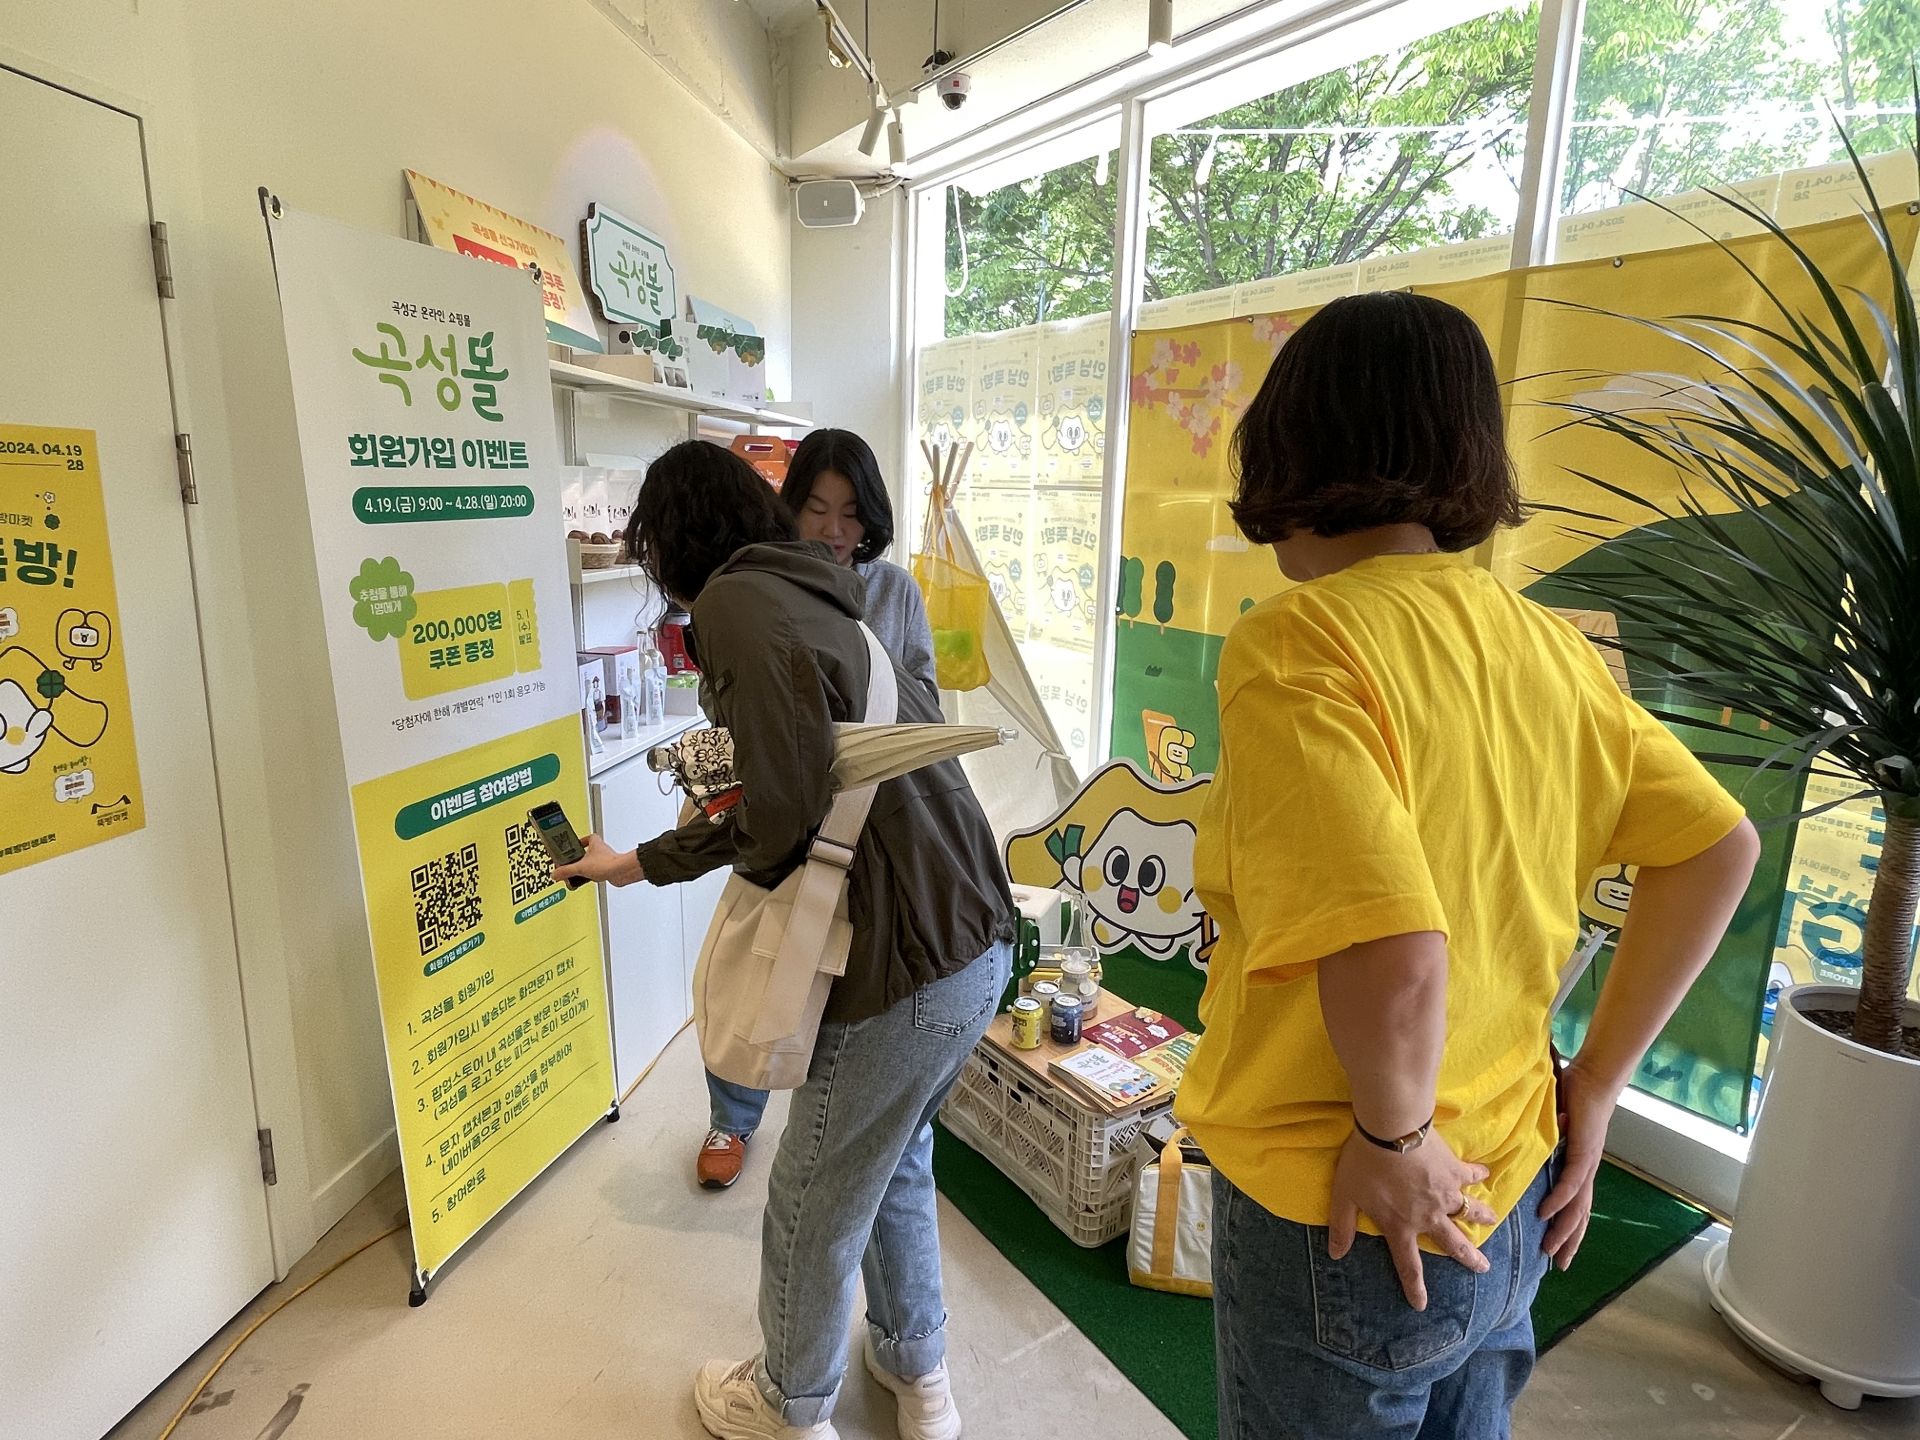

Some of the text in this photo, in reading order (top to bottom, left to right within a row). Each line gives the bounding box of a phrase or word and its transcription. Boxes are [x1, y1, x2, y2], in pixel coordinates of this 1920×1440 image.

[608, 250, 664, 316] 곡성몰
[391, 301, 471, 328] 곡성군 온라인 쇼핑몰
[352, 322, 509, 422] 곡성몰
[66, 459, 84, 471] 28
[348, 433, 529, 470] 회원가입 이벤트
[364, 496, 416, 514] 4.19.(금)
[419, 497, 443, 511] 9:00
[455, 494, 498, 511] 4.28.(일)
[500, 494, 527, 508] 20:00
[360, 584, 408, 602] 추첨을 통해
[370, 602, 402, 616] 1명에게
[412, 610, 502, 645] 200,000원
[518, 622, 531, 633] (수)
[518, 633, 533, 646] 발표
[429, 638, 495, 670] 쿠폰 증정
[433, 707, 451, 719] 한해
[452, 697, 485, 715] 개별연락
[504, 688, 515, 701] 1회
[516, 685, 531, 698] 응모
[532, 681, 546, 693] 가능
[430, 766, 533, 821] 이벤트 참여방법
[429, 935, 481, 971] 회원가입 바로가기
[407, 969, 495, 1036] 1. 곡성몰 회원가입
[412, 1060, 424, 1076] 2.
[427, 1019, 480, 1065] 회원가입시
[482, 996, 516, 1028] 발송되는
[417, 987, 580, 1112] 3. 팝업스토어 내 곡성몰존 방문 인증샷
[433, 998, 590, 1121] (곡성몰 로고 또는 피크닉 존이 보이게)
[425, 1042, 573, 1168] 4. 문자 캡처본과 인증샷을 첨부하여
[441, 1078, 549, 1176] 네이버폼으로 이벤트 참여
[431, 1168, 487, 1224] 5. 참여완료
